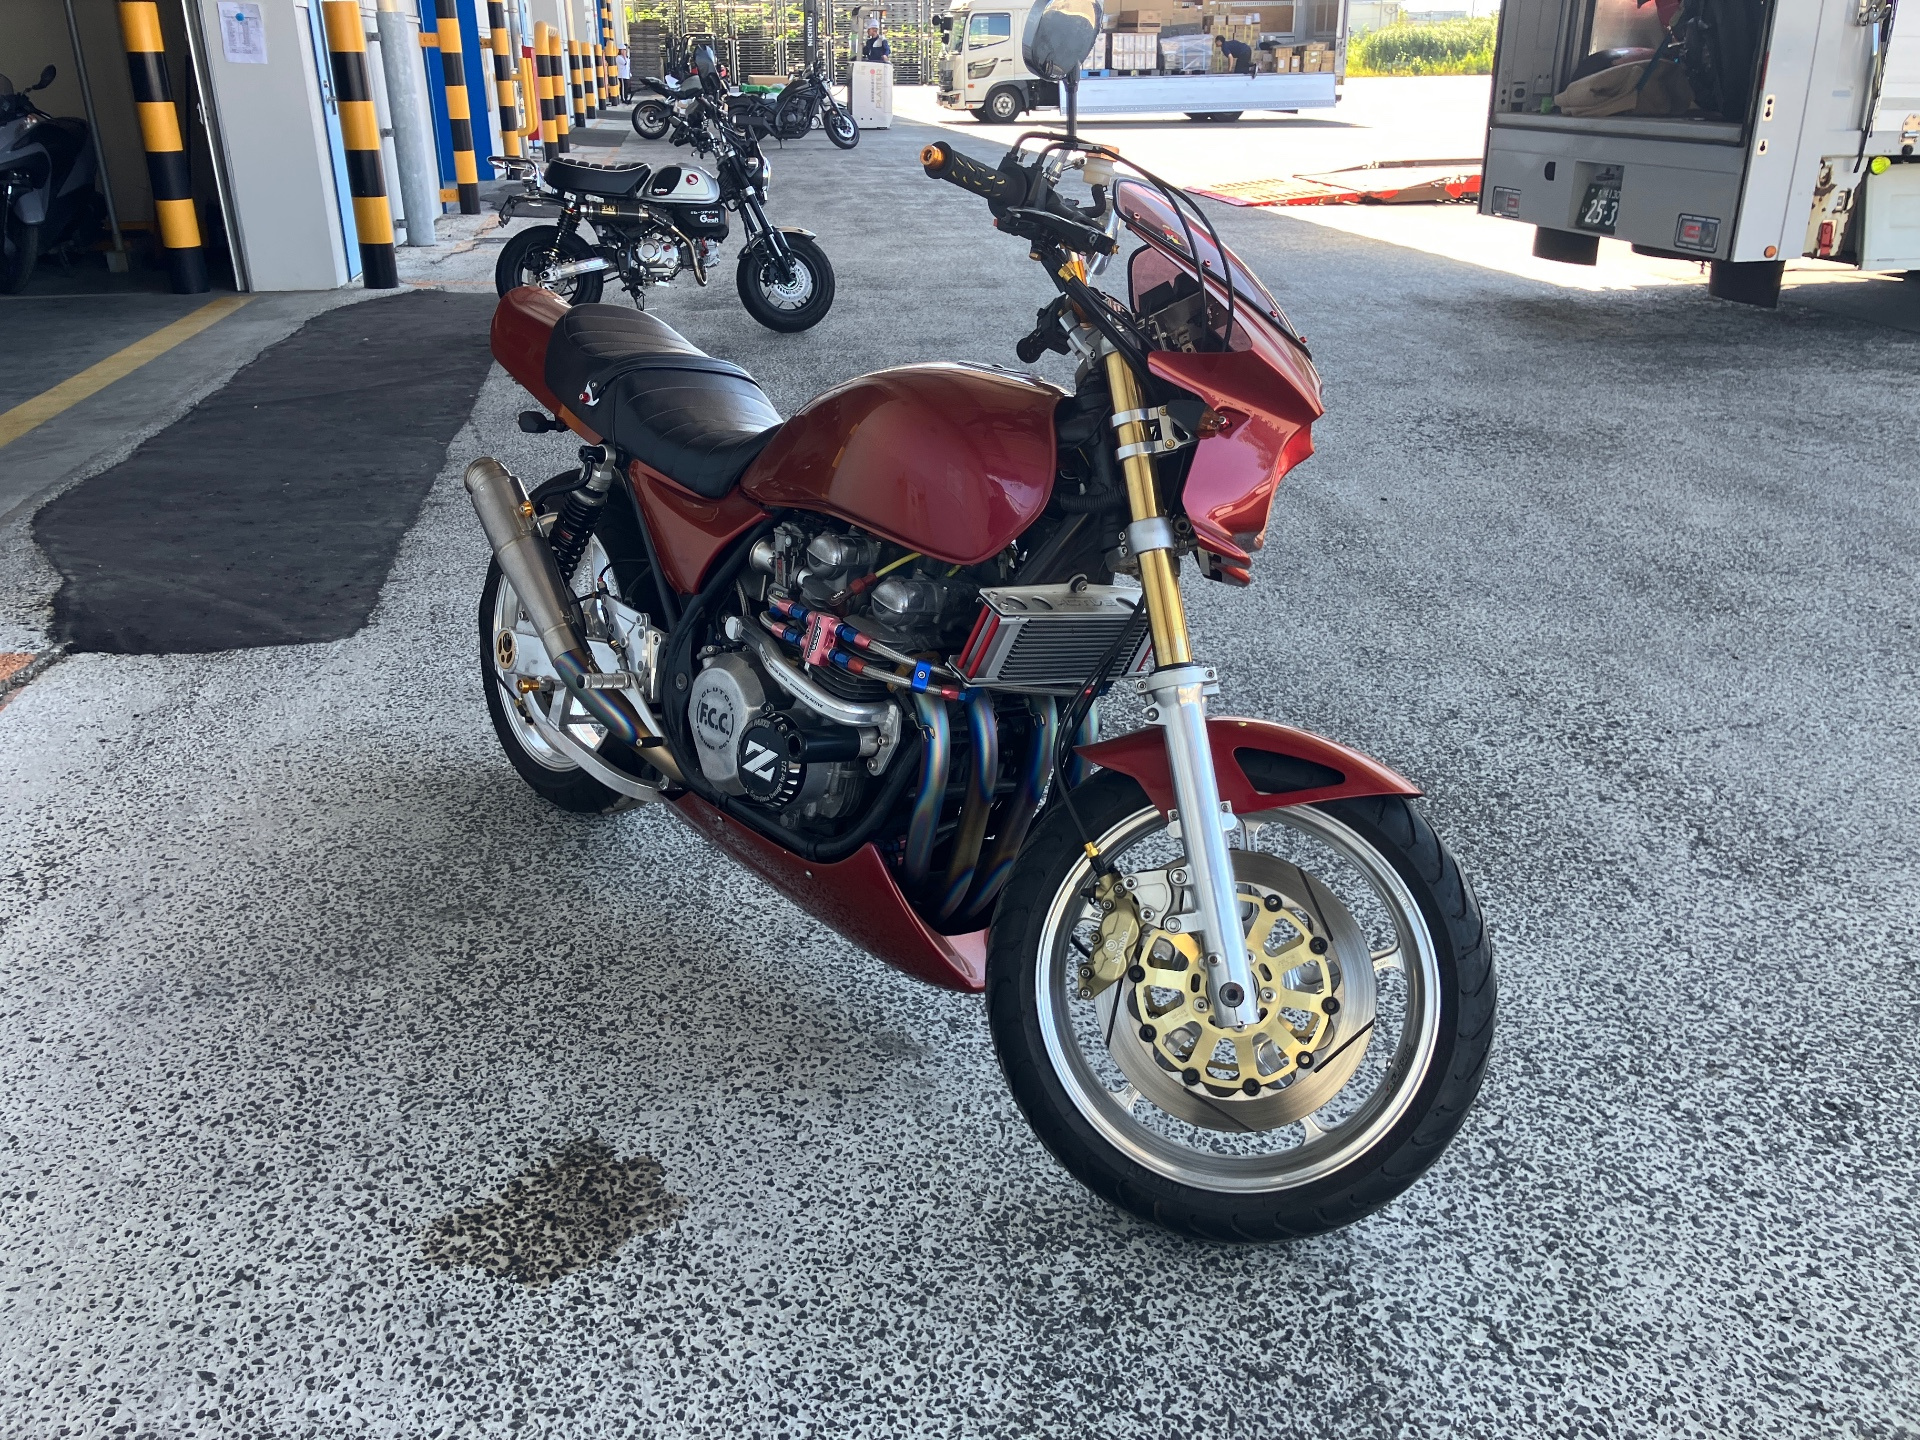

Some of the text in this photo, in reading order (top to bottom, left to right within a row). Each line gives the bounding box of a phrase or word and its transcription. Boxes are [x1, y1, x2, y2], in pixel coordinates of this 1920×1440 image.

[1584, 199, 1618, 226] 25-3
[701, 687, 734, 711] CLUTCH
[699, 702, 730, 736] F.C.C.
[1111, 931, 1128, 964] brembo
